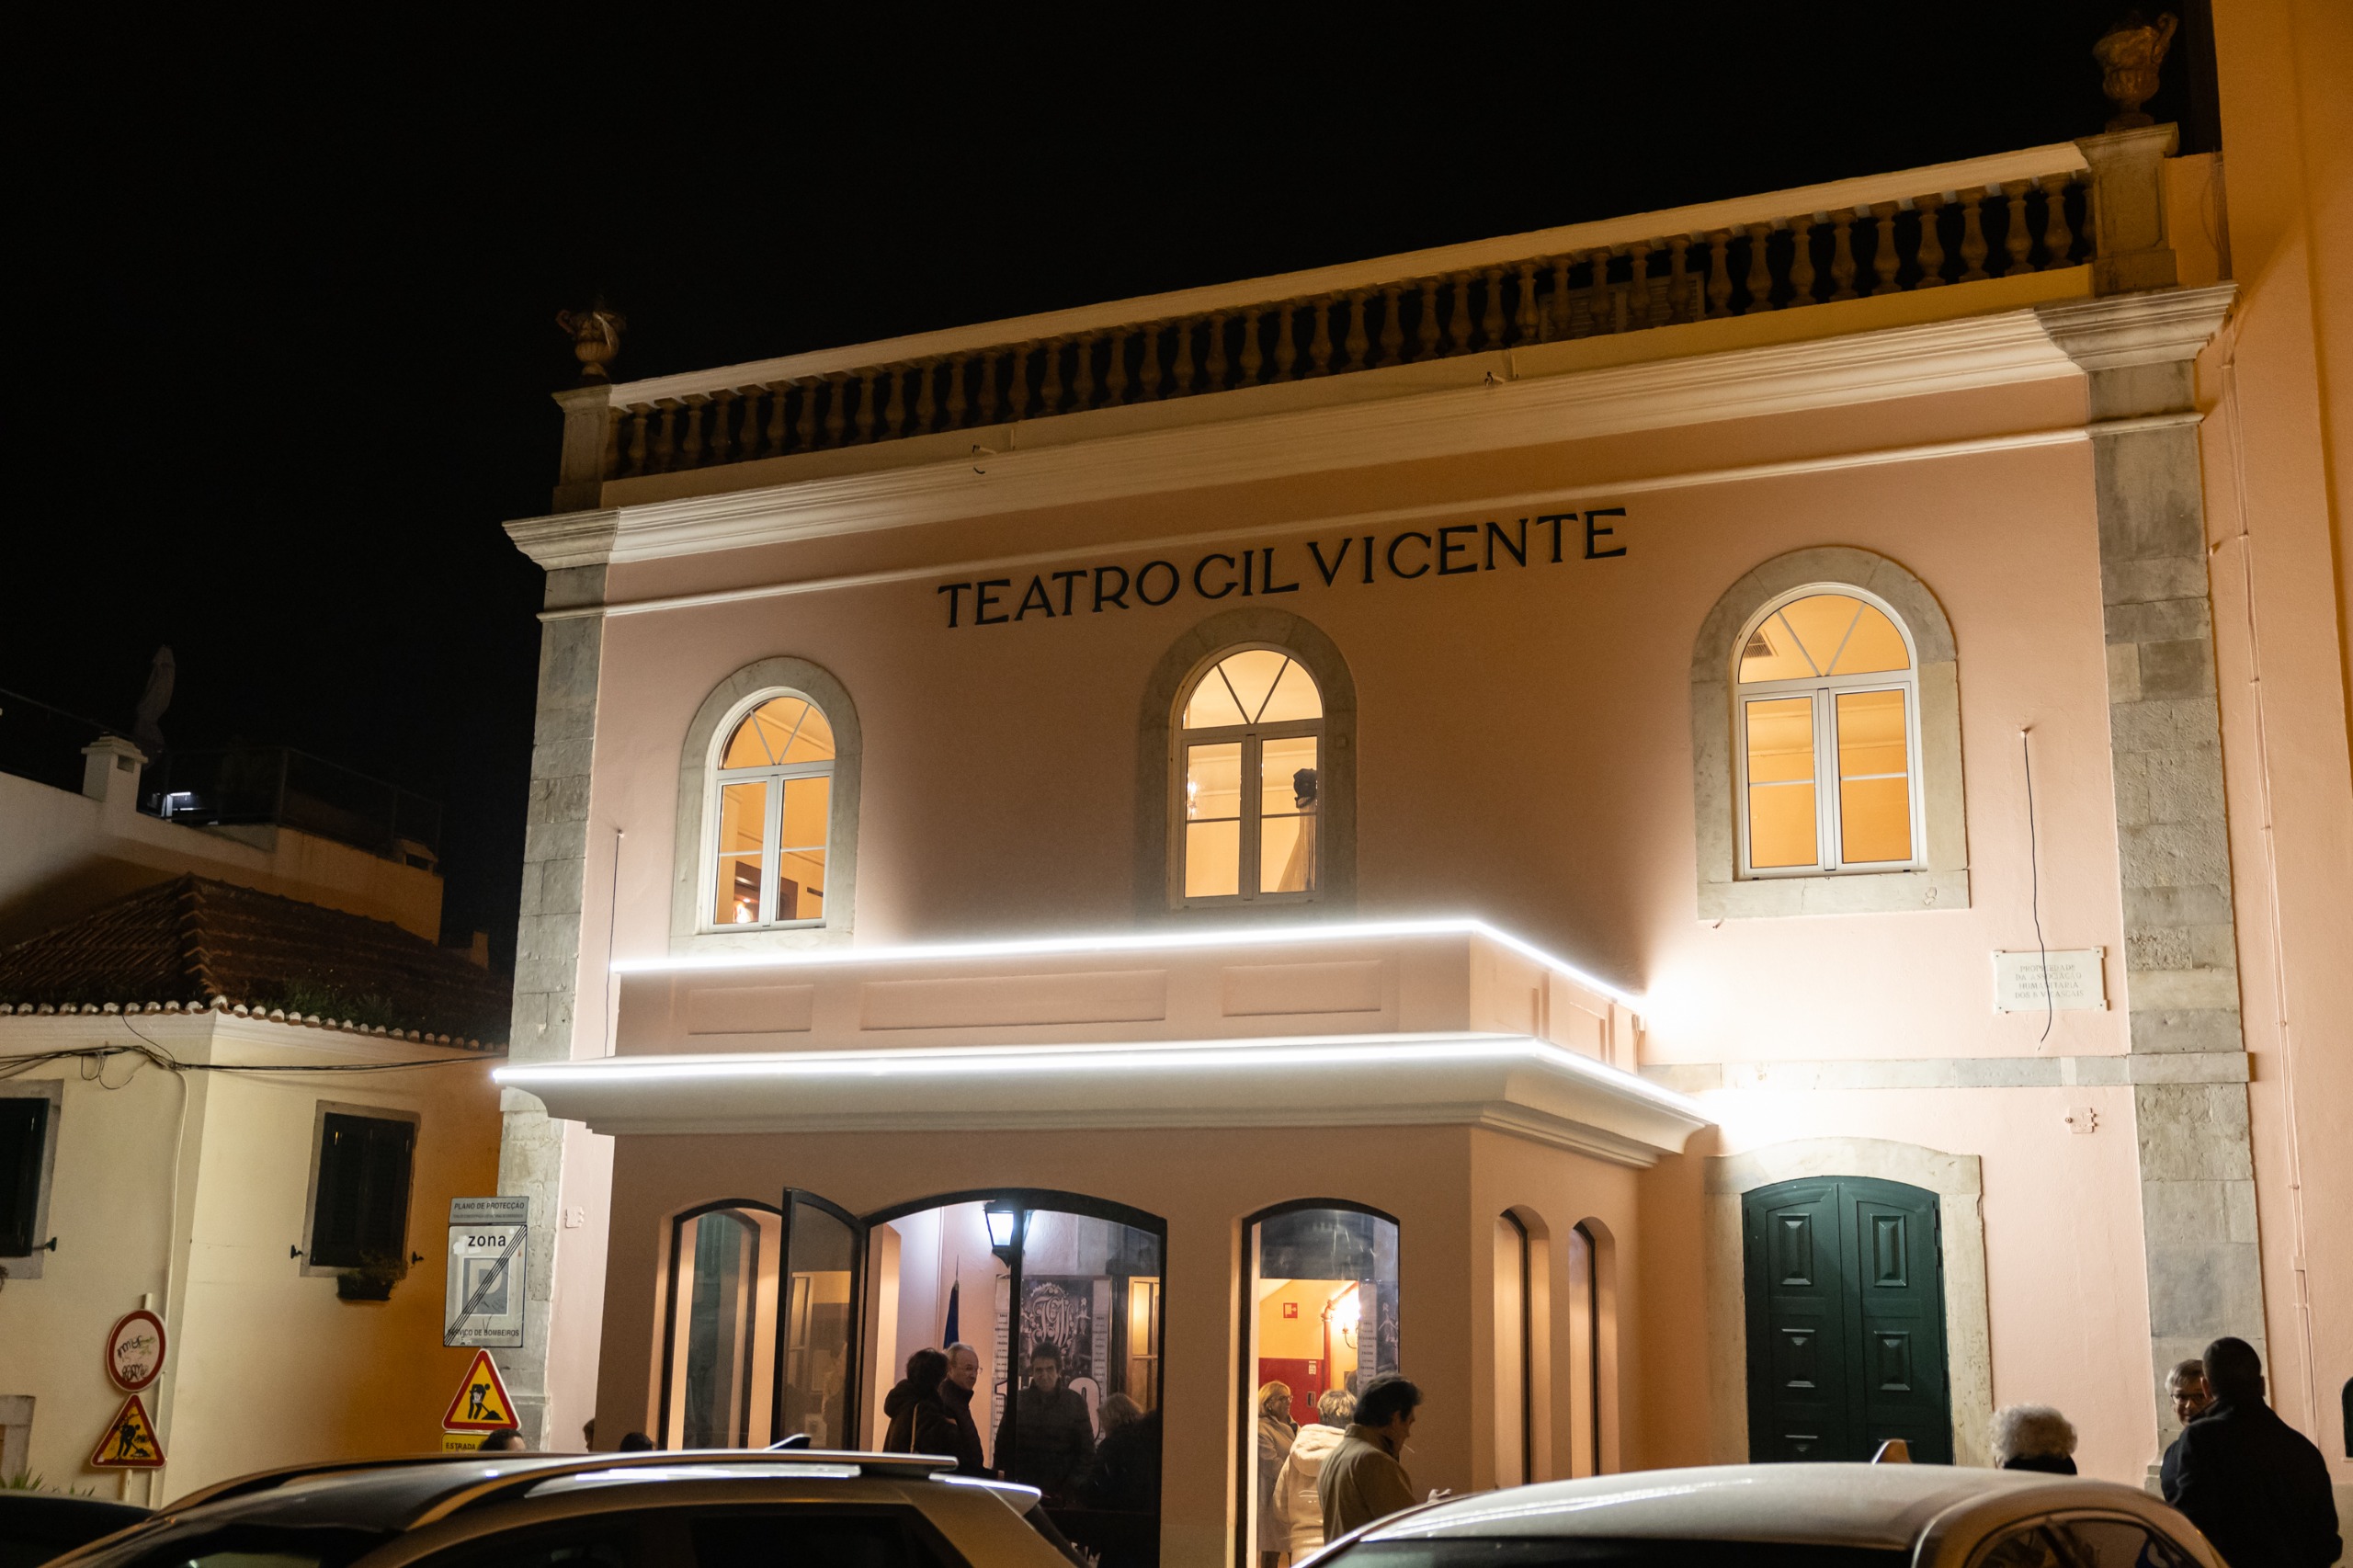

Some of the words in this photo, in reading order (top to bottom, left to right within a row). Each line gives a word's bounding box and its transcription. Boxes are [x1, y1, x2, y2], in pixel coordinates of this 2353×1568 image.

[938, 561, 1180, 628] TEATRO
[1194, 547, 1299, 599] GIL
[1306, 507, 1628, 586] VICENTE
[486, 1200, 525, 1210] PROTECÇÃO
[468, 1234, 506, 1247] zona
[483, 1329, 520, 1337] BOMBEIROS
[446, 1442, 476, 1450] ESTRADA
